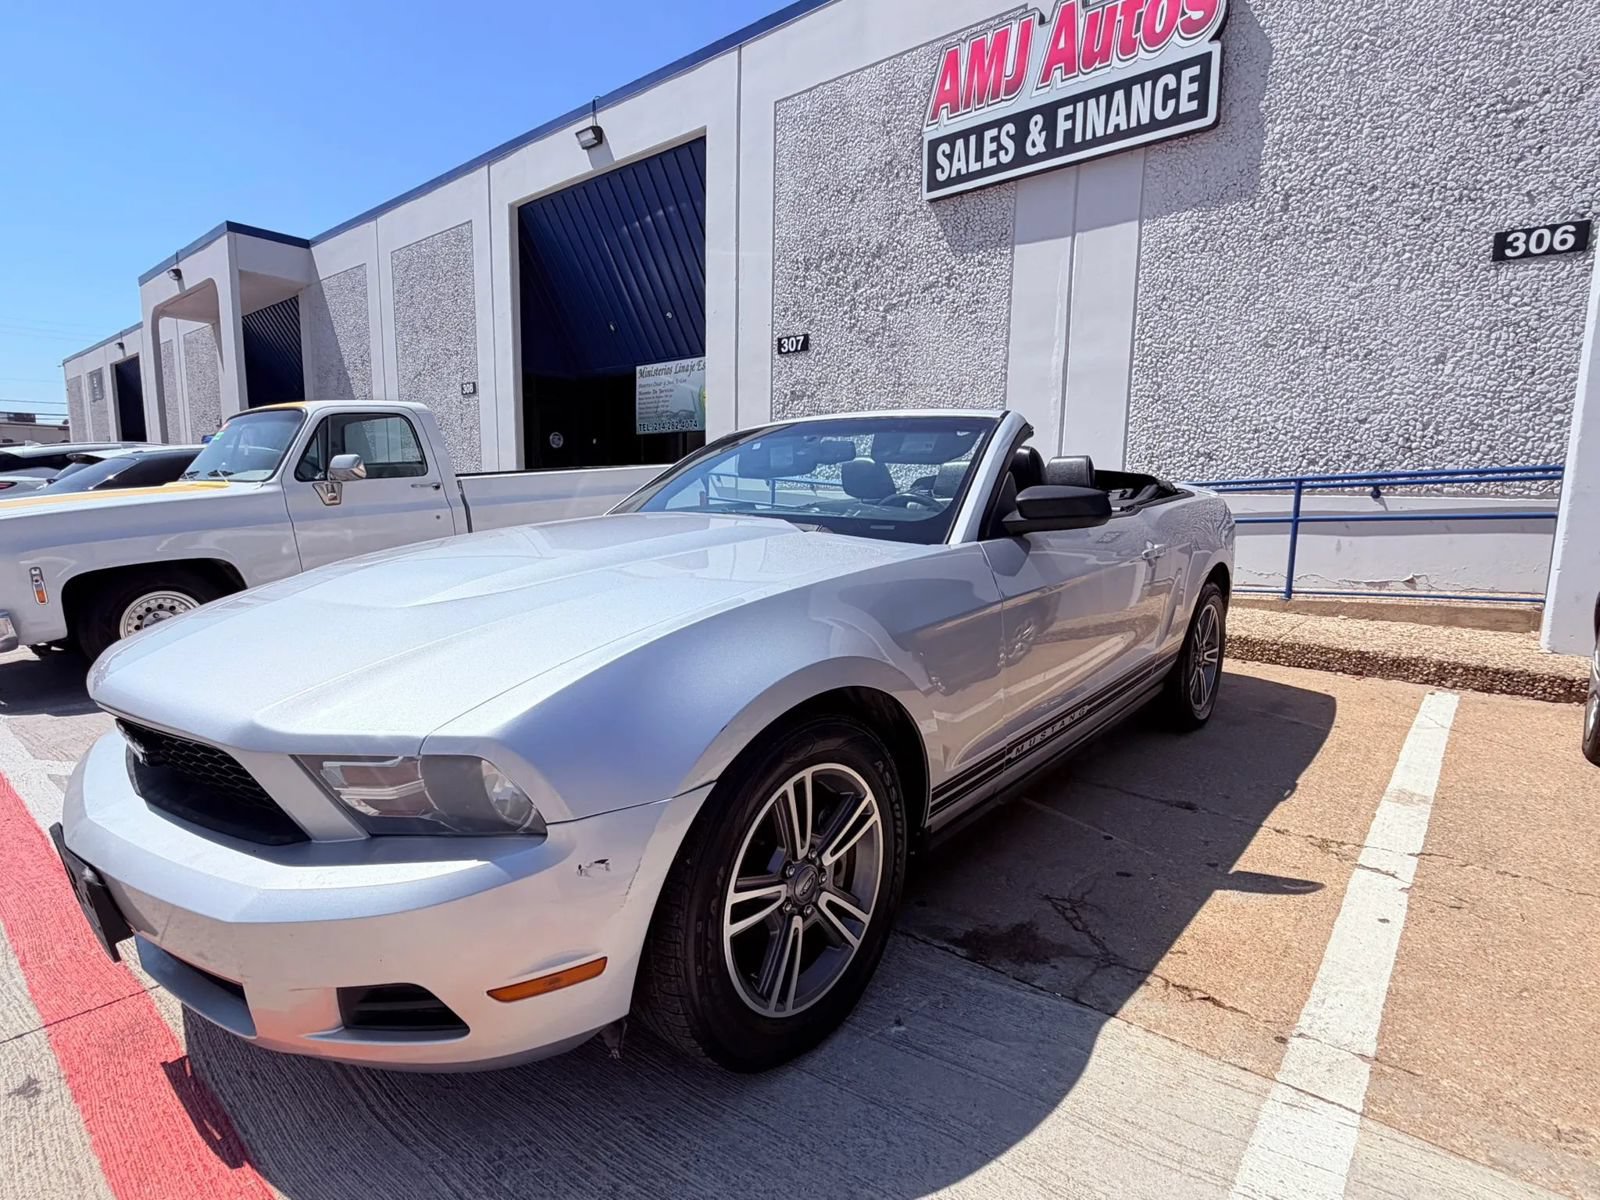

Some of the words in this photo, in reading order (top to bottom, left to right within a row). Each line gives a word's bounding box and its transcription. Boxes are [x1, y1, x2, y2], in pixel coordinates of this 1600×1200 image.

[926, 16, 1035, 126] AMJ
[935, 122, 1017, 182] SALES
[1025, 113, 1047, 156] &
[1055, 65, 1201, 148] FINANCE
[1504, 224, 1577, 258] 306
[780, 335, 805, 353] 307
[1014, 705, 1089, 756] MUSTANG
